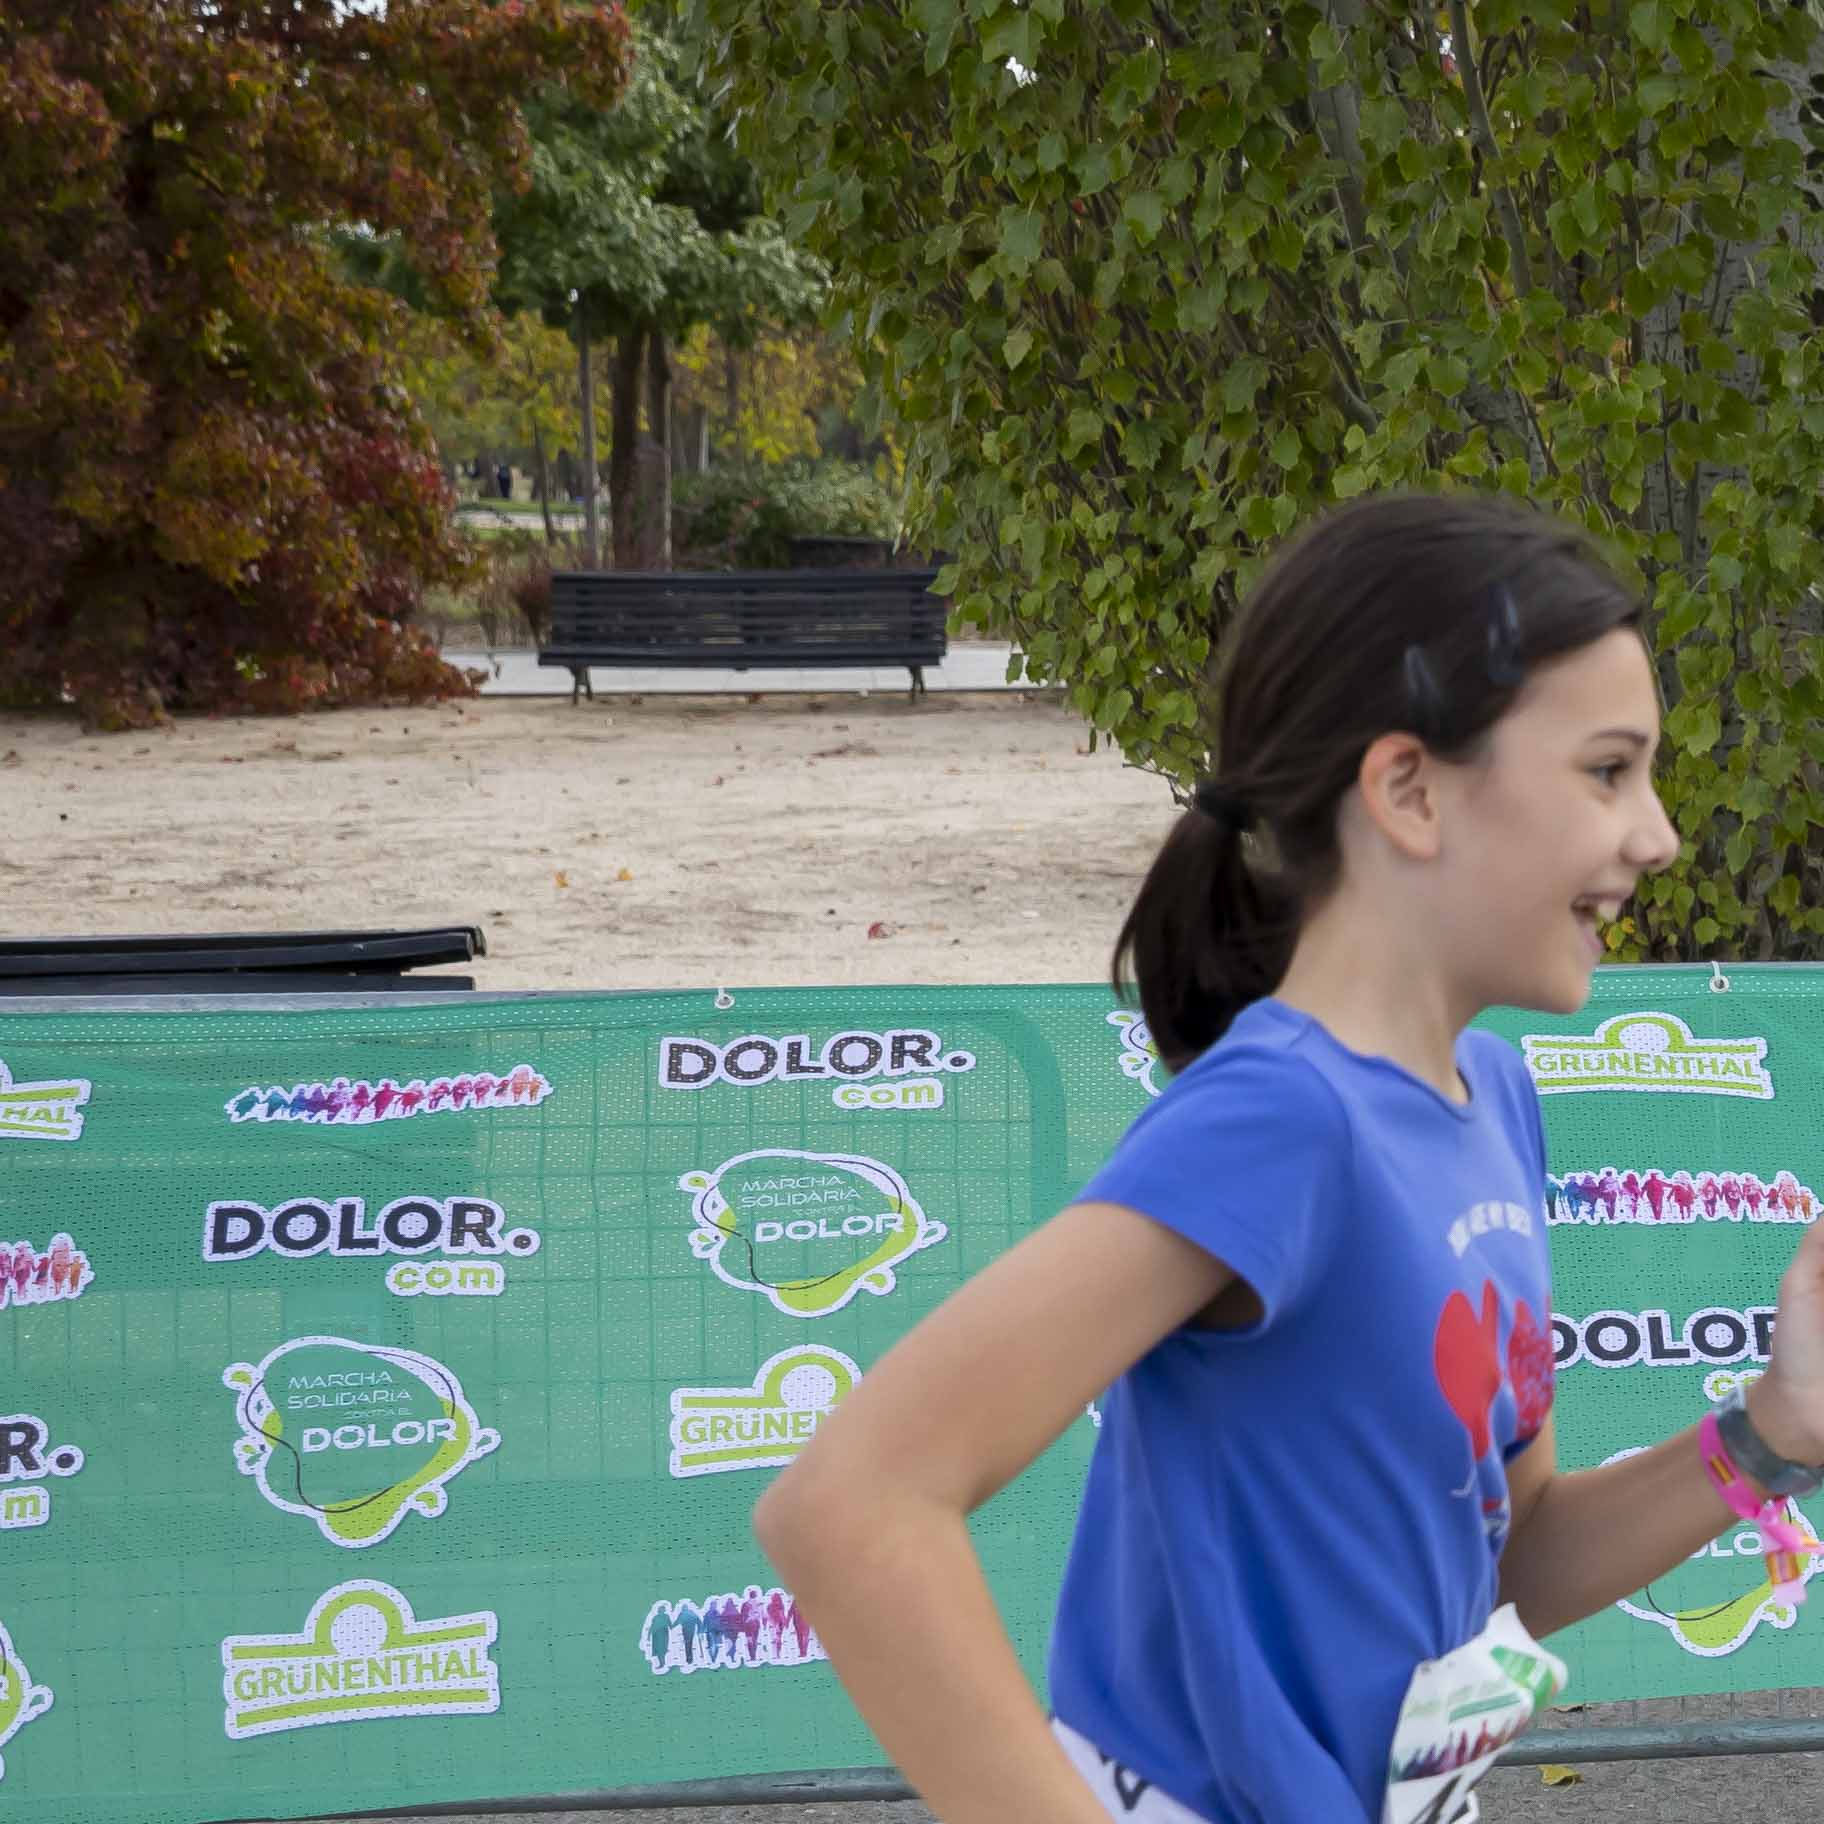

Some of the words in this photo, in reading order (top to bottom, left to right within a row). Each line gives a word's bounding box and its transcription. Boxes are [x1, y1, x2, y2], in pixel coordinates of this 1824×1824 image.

[667, 1034, 968, 1084] DOLOR.
[1533, 1051, 1761, 1080] GRÜNENTHAL
[840, 1083, 936, 1104] com
[742, 1175, 845, 1193] MARCHA
[741, 1189, 864, 1208] SOLIDARIA
[211, 1203, 532, 1253] DOLOR.
[755, 1213, 905, 1242] DOLOR
[393, 1265, 496, 1289] com
[288, 1371, 392, 1389] MARCHA
[287, 1390, 413, 1409] SOLIDARIA
[303, 1418, 460, 1453] DOLOR
[233, 1648, 487, 1701] GRÜNENTHAL
